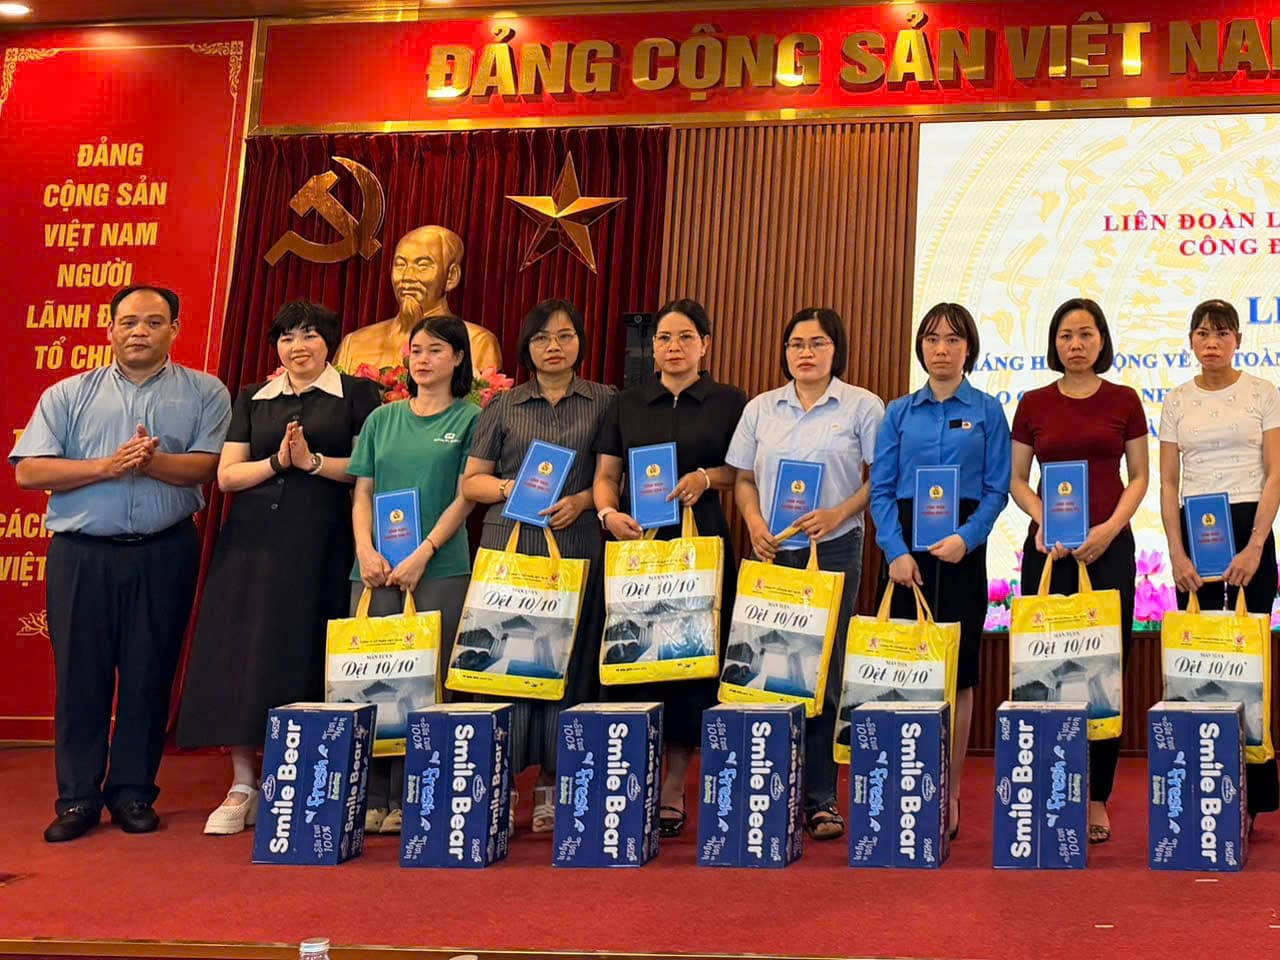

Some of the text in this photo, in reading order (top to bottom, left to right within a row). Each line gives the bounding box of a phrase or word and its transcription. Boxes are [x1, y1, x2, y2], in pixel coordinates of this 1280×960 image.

[426, 23, 620, 103] ĐẢNG
[631, 25, 819, 102] CỘNG
[840, 11, 990, 90] SẢN
[1009, 11, 1152, 88] VIỆT
[77, 136, 144, 167] ĐẢNG
[43, 175, 167, 212] CỘNG SẢN
[44, 219, 158, 252] VIỆT NAM
[1103, 210, 1168, 231] LIÊN
[1178, 209, 1255, 230] ĐOÀN
[1179, 234, 1258, 256] CÔNG
[57, 257, 133, 287] NGƯỜI
[26, 300, 91, 328] LÃNH
[35, 336, 67, 369] TỔ
[1112, 353, 1158, 373] ỘNG
[517, 596, 558, 614] 10/10
[773, 610, 808, 628] 10/10
[1064, 636, 1100, 655] 10/10
[375, 659, 415, 676] 10/10
[892, 669, 928, 686] 10/10
[1208, 661, 1244, 678] 10/10
[270, 719, 301, 853] Smile Bear
[449, 725, 476, 860] Smile Bear
[604, 723, 630, 859] Smile Bear
[748, 721, 771, 858] Smile Bear
[900, 722, 922, 859] Smile Bear
[1007, 719, 1034, 857] Smile Bear
[1200, 722, 1224, 863] Smile Bear
